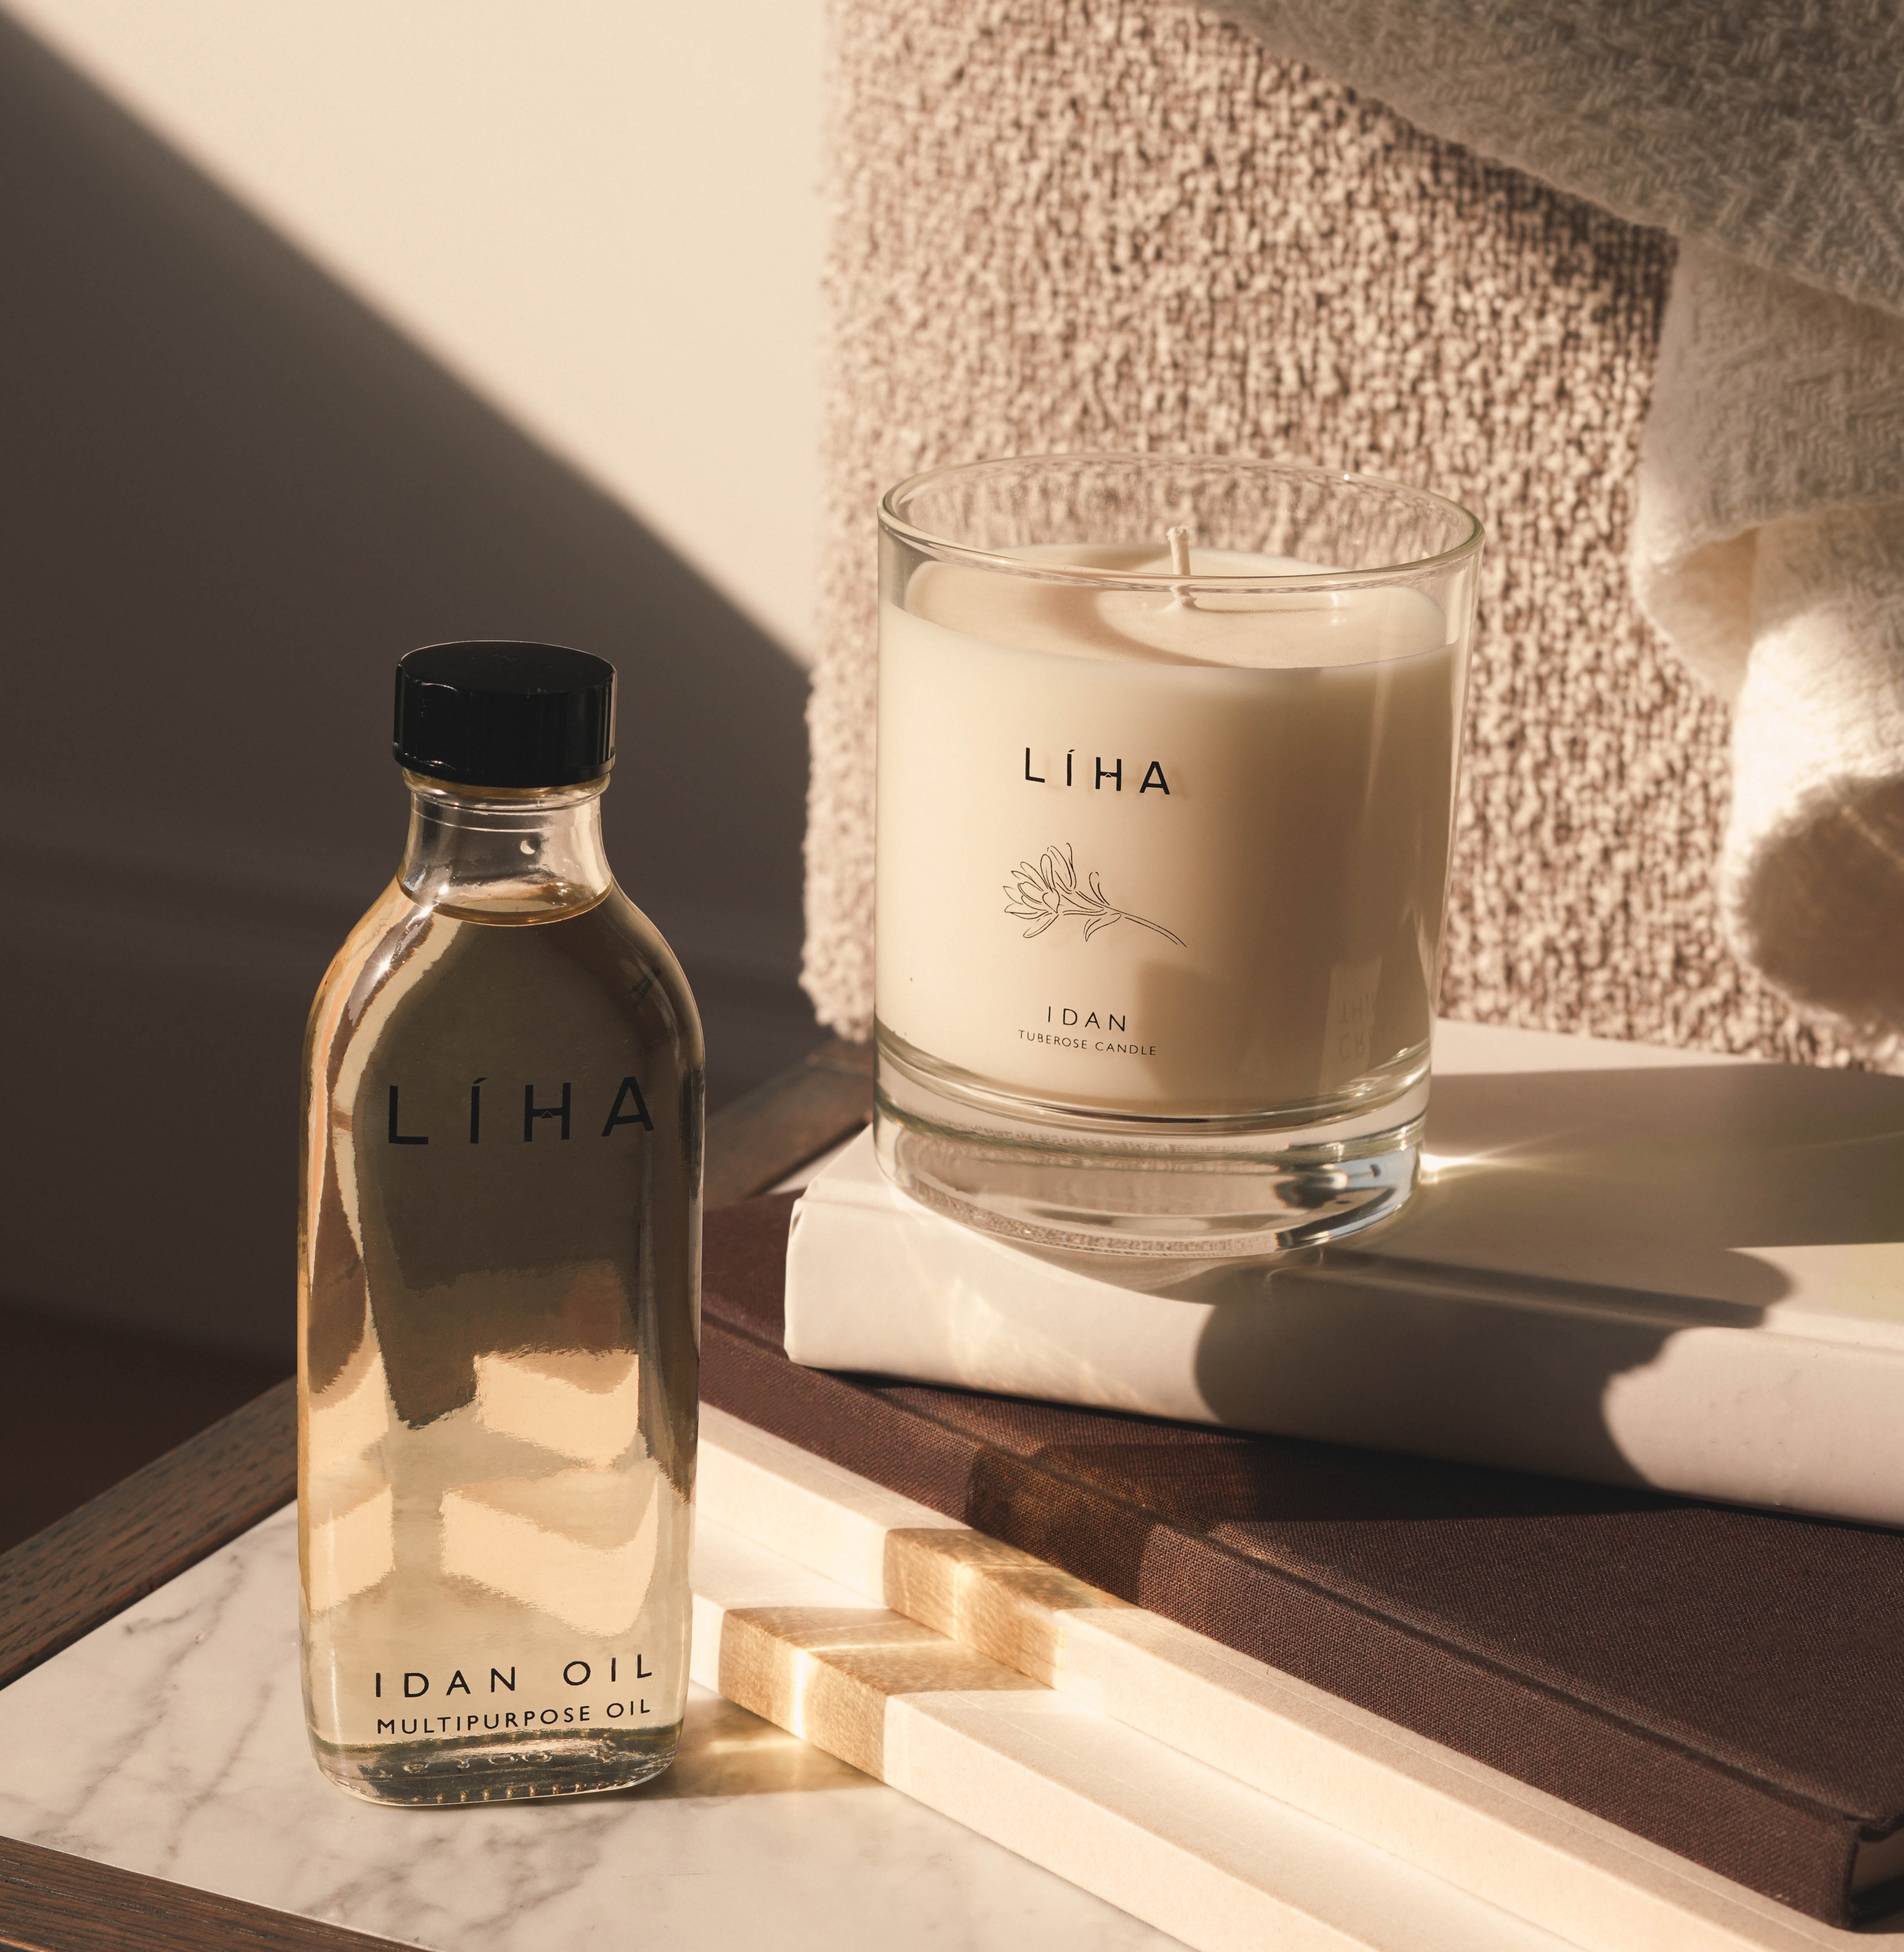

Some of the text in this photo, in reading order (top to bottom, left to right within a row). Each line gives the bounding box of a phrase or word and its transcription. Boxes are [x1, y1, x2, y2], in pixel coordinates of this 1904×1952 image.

[1048, 1006, 1125, 1032] IDAN
[1018, 1030, 1156, 1055] TUBEROSE CANDLE
[375, 1654, 653, 1698] IDAN OIL
[377, 1699, 650, 1734] MULTIPURPOSE OIL
